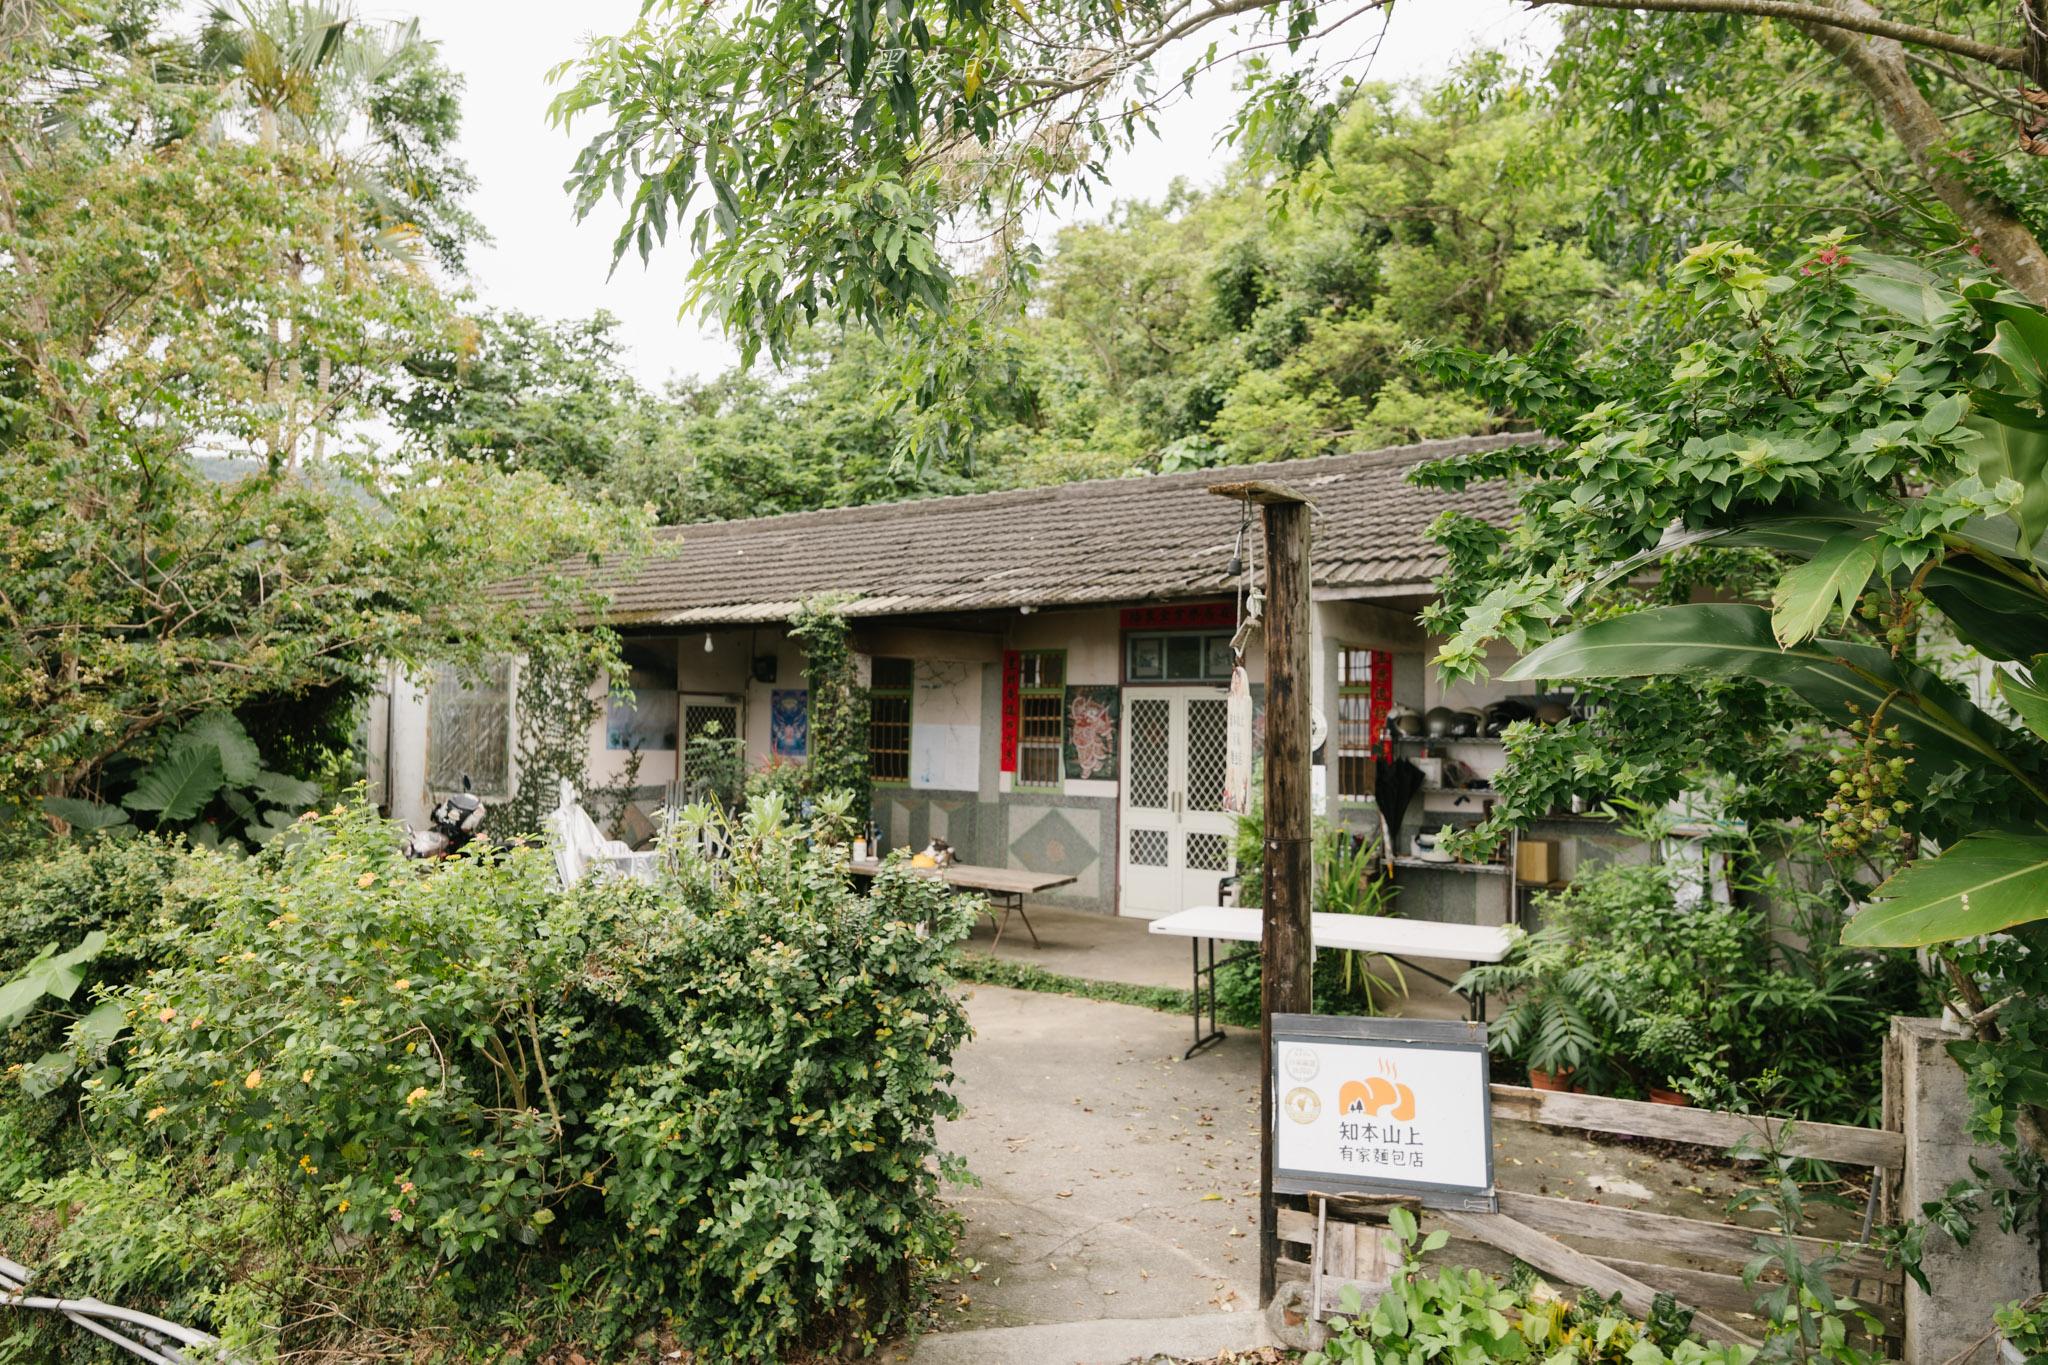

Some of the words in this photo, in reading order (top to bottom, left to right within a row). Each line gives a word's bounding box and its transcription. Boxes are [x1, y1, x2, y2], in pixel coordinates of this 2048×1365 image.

[1339, 1121, 1424, 1146] 知本山上
[1339, 1145, 1423, 1167] 有家麵包店
